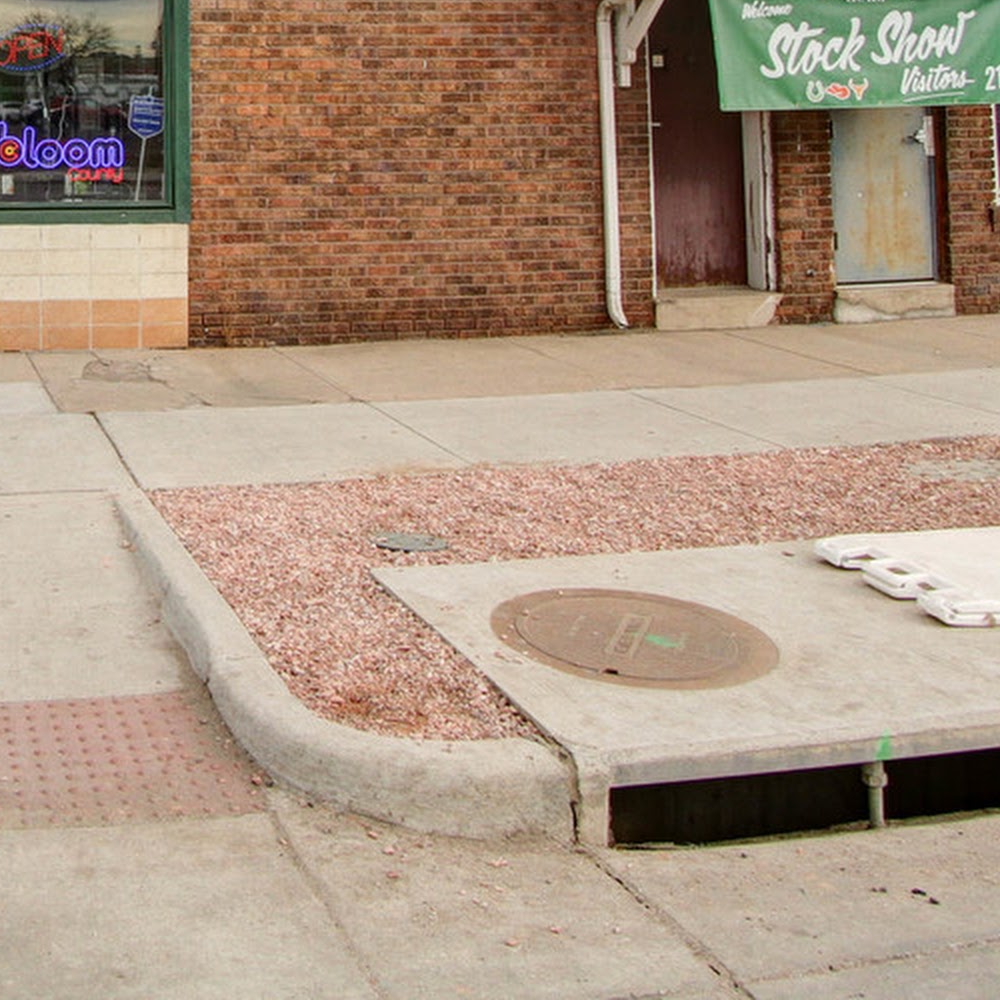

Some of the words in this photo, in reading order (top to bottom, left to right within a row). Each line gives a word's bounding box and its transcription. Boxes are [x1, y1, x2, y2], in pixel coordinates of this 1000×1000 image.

[741, 0, 794, 20] Welcome
[760, 16, 866, 79] Stock
[870, 9, 977, 66] Show
[900, 64, 975, 95] Visitors
